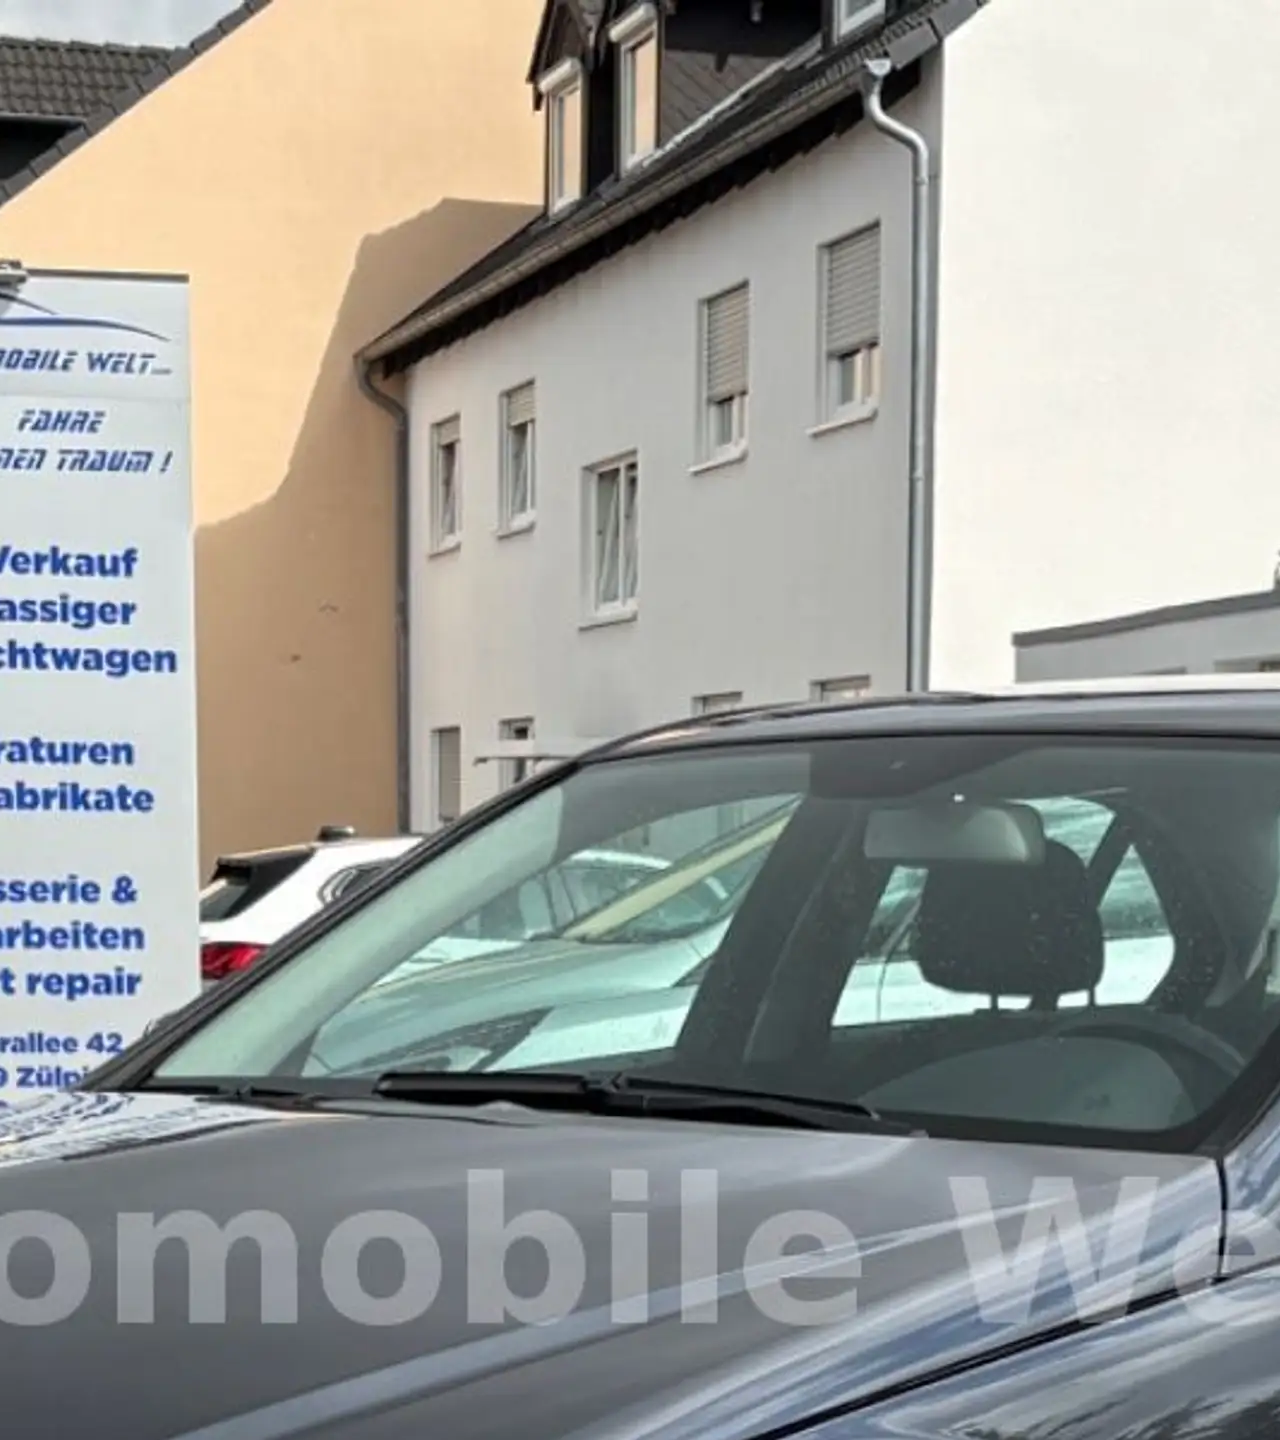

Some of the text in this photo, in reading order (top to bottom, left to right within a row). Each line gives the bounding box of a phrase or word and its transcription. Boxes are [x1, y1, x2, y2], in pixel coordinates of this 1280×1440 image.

[18, 409, 105, 434] FAHRE
[57, 449, 154, 473] TRAUM
[159, 451, 174, 473] !
[111, 875, 138, 904] &
[26, 966, 142, 1001] repair
[86, 1033, 122, 1054] 42
